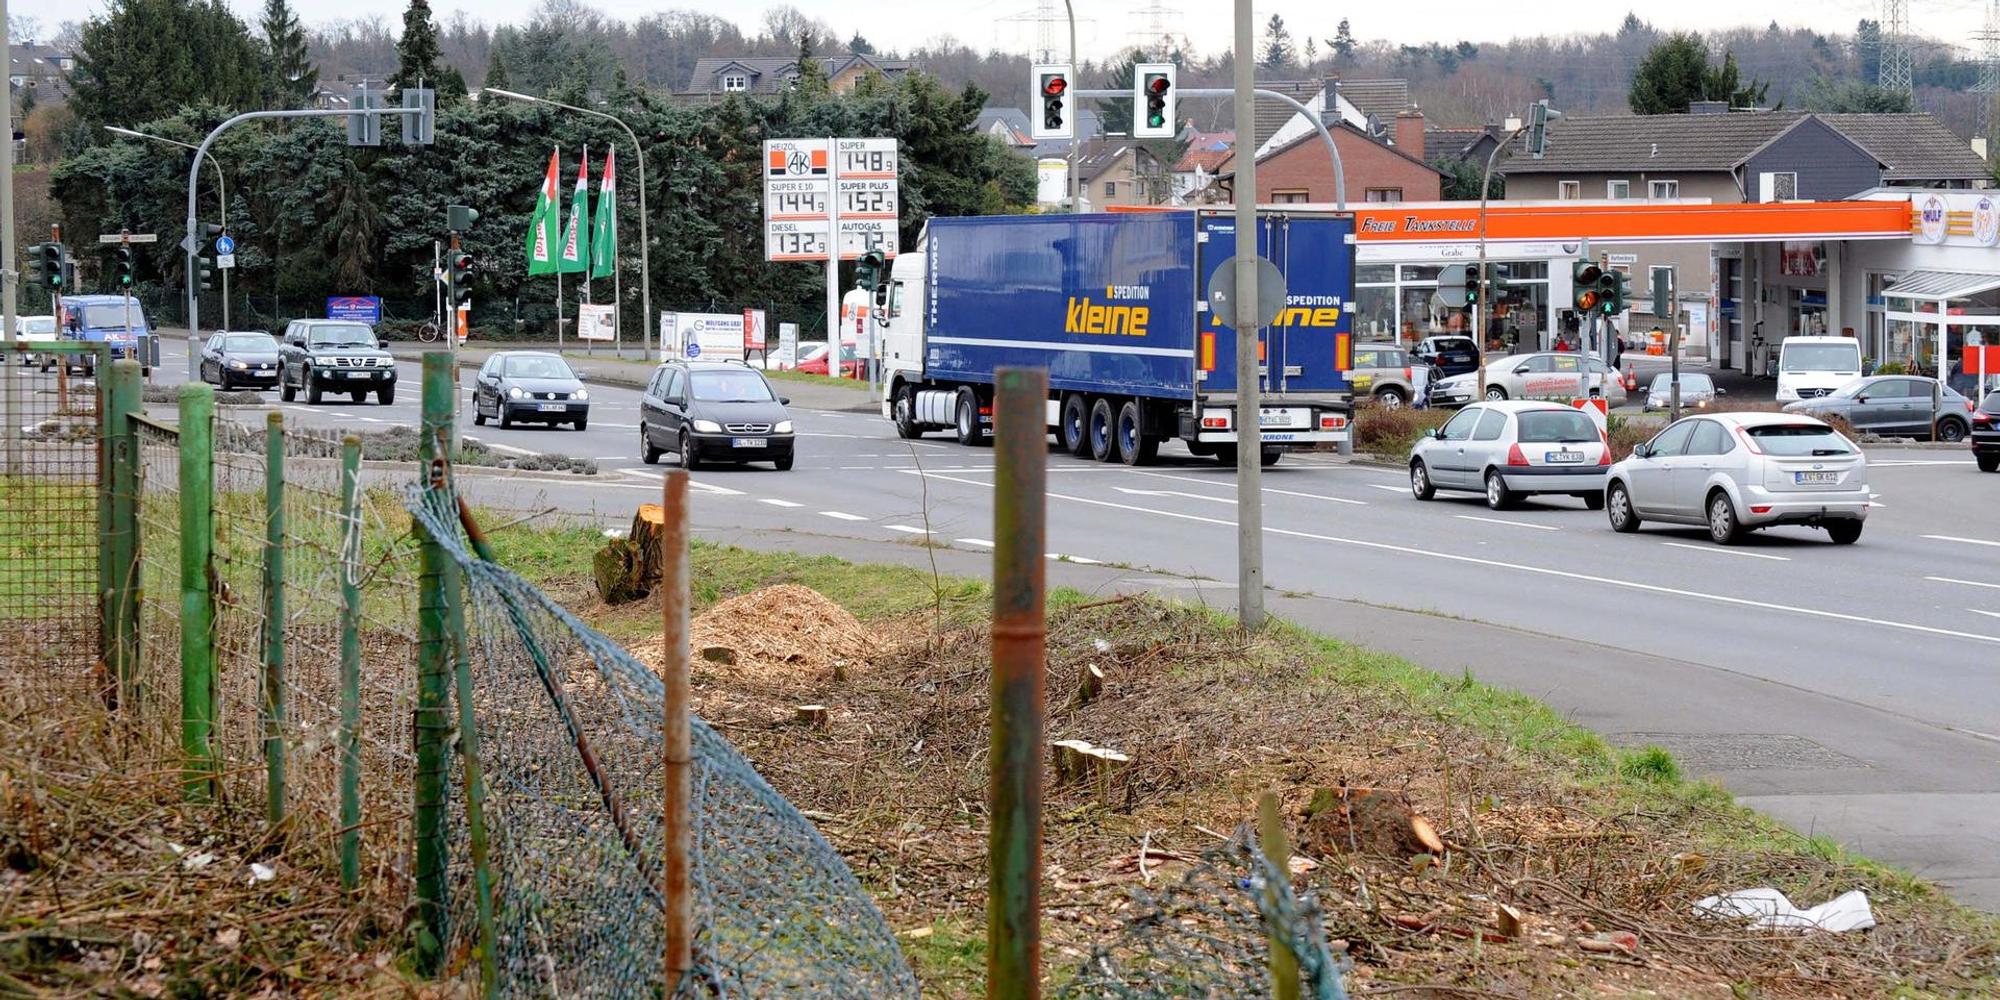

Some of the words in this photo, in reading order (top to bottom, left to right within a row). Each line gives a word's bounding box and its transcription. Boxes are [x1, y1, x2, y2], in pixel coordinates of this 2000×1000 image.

[840, 141, 866, 150] SUPER
[771, 183, 797, 191] SUPER
[841, 182, 867, 191] SUPER
[869, 182, 889, 190] PLUS
[771, 223, 799, 232] DIESEL
[841, 222, 882, 231] AUTOGAS
[536, 222, 546, 258] astrol
[931, 236, 939, 328] THERMO
[1113, 285, 1150, 300] SPEDITION
[1286, 295, 1340, 306] SPEDITION
[1065, 296, 1149, 336] kleine
[1262, 433, 1296, 441] KRONE
